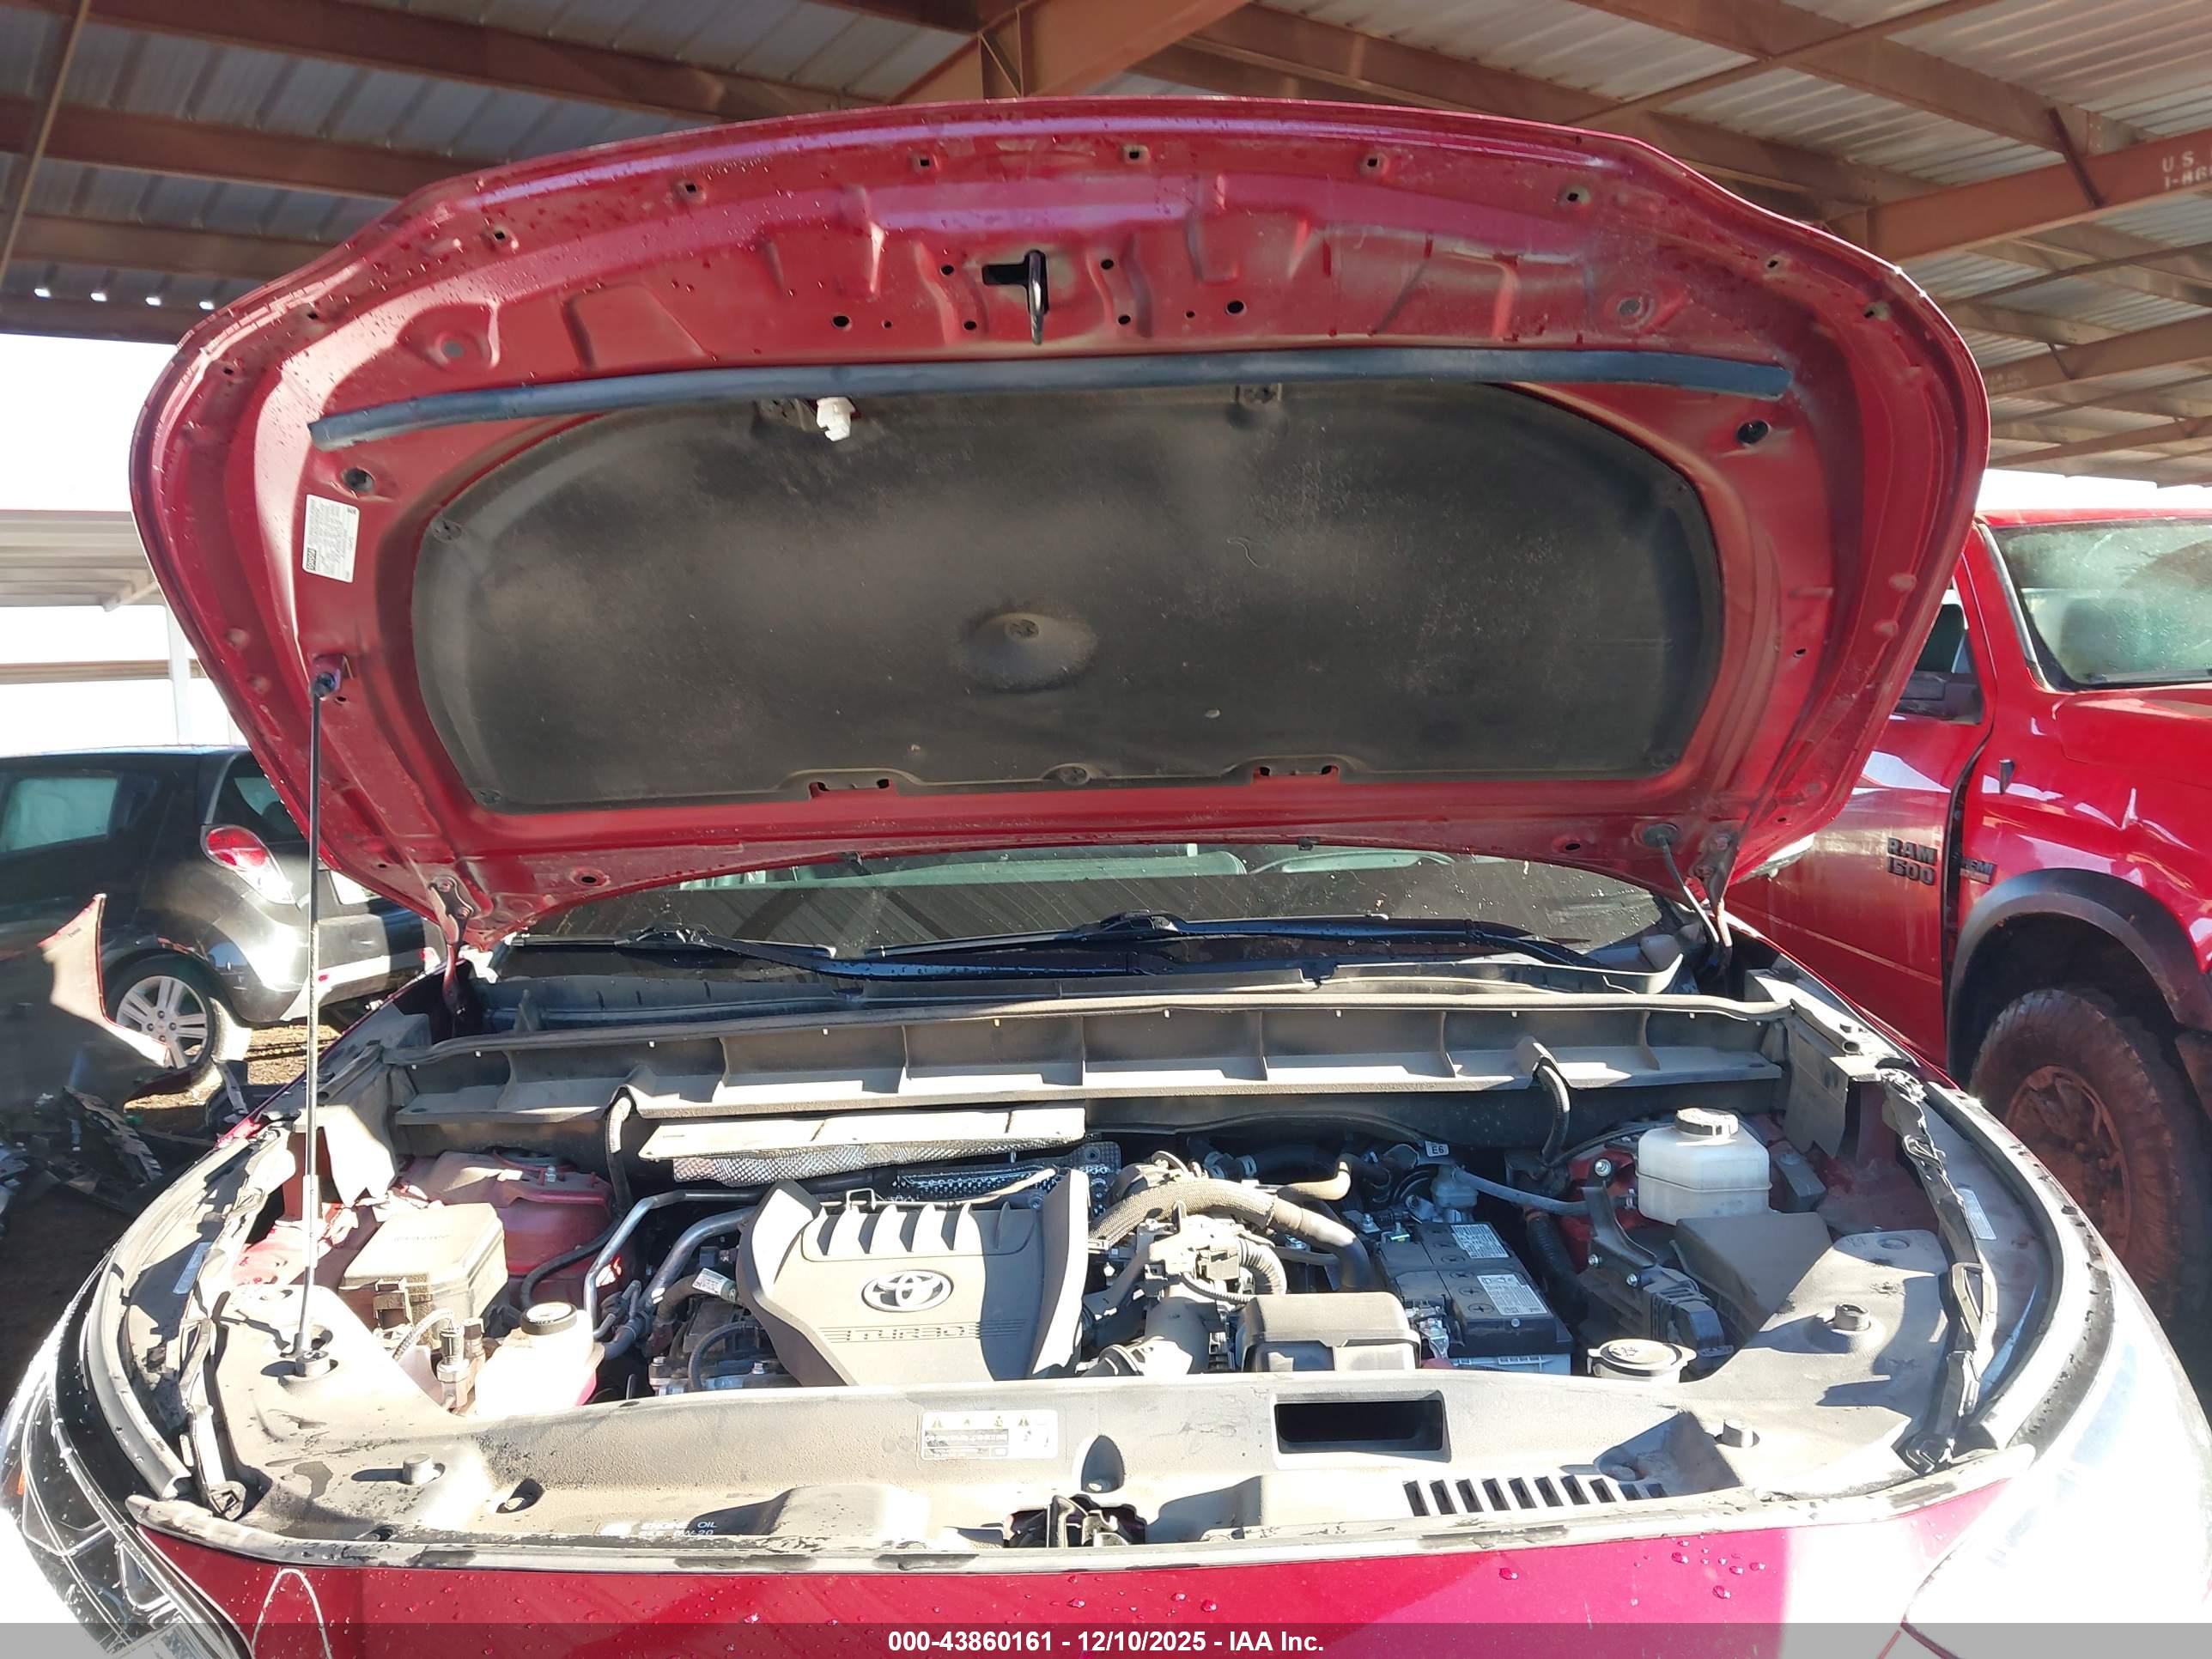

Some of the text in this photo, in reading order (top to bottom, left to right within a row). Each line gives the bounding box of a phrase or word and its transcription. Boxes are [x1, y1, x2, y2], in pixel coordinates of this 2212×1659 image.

[1887, 837, 1937, 866] RAM
[1887, 857, 1936, 886] 1500
[1431, 1146, 1444, 1154] E6
